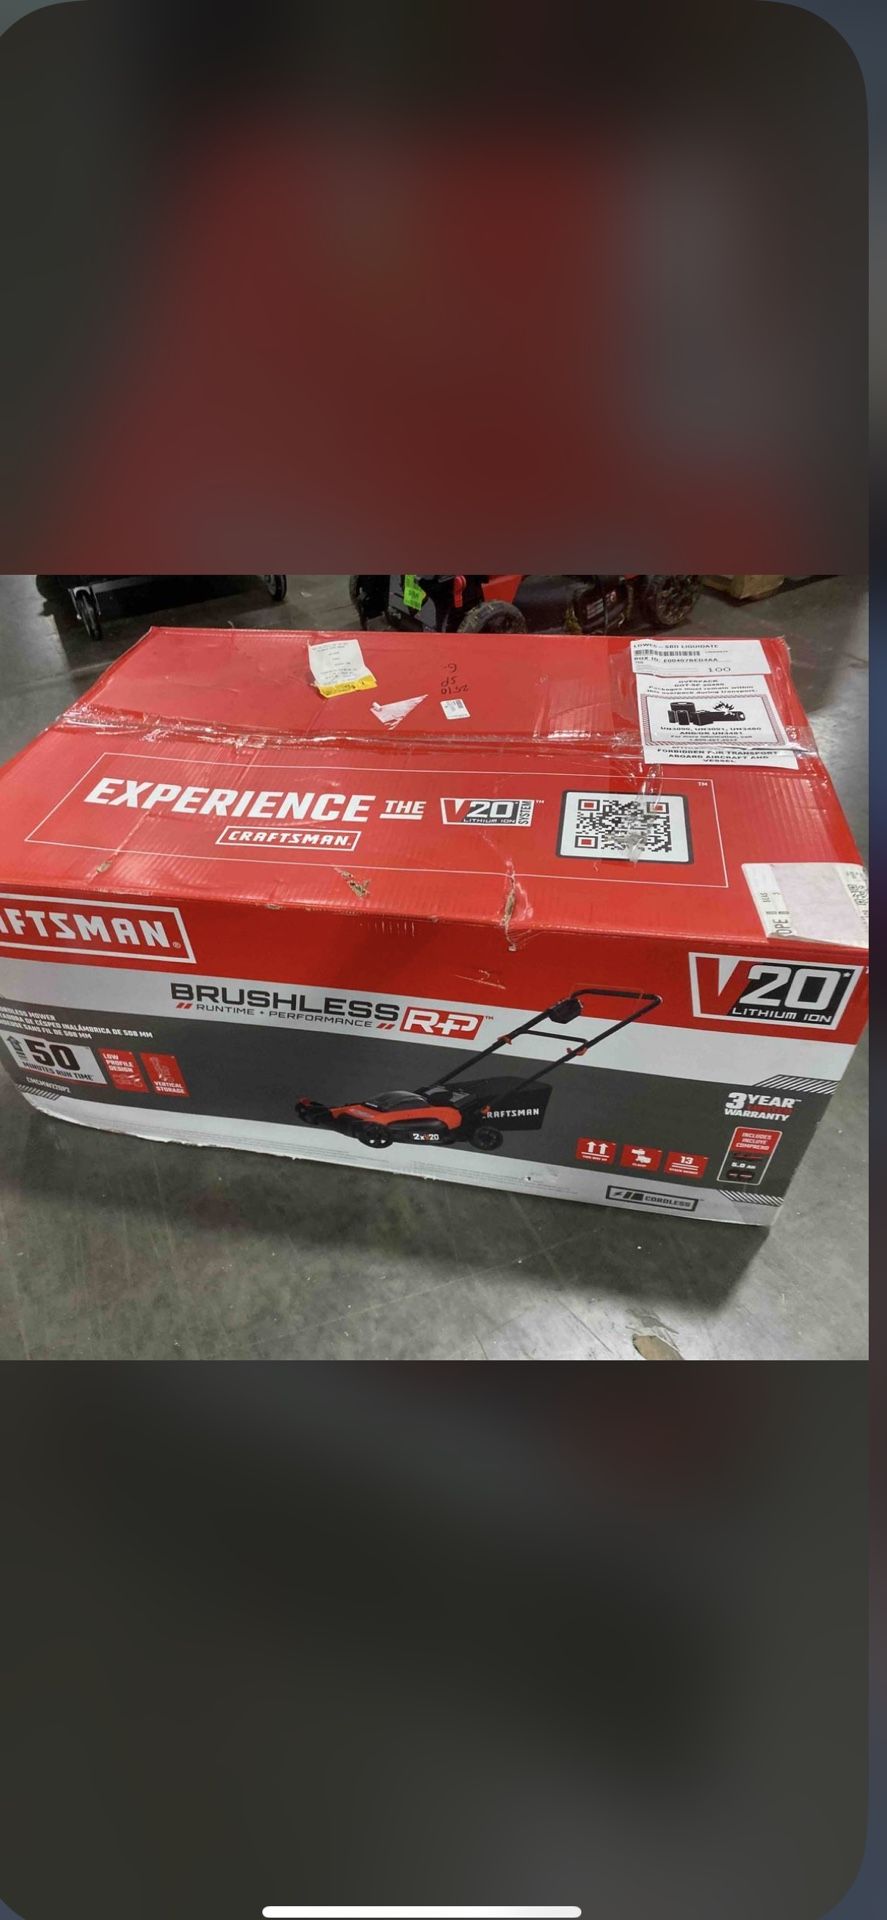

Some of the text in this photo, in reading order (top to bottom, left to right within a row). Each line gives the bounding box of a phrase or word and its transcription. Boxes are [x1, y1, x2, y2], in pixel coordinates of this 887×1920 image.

[84, 777, 376, 822] EXPERIENCE
[384, 800, 427, 815] THE
[518, 801, 532, 824] SYSTEM
[228, 831, 348, 847] CRAFTSMAN
[170, 982, 400, 1022] BRUSHLESS
[28, 1011, 56, 1021] MOWER
[196, 1004, 255, 1016] RUNTIME
[269, 1010, 372, 1028] PERFORMANCE
[732, 1007, 833, 1023] LITHIUM ION
[23, 1024, 41, 1032] SANS
[41, 1027, 53, 1035] FIL
[62, 1022, 111, 1035] INALÁMBRICA
[112, 1029, 121, 1037] DE
[139, 1031, 153, 1039] MM
[24, 1038, 81, 1071] 50
[103, 1052, 119, 1060] LOW
[22, 1061, 55, 1074] MINUTES
[55, 1069, 72, 1078] RUN
[106, 1059, 134, 1068] PROFILE
[108, 1065, 134, 1073] DESIGN
[156, 1086, 186, 1094] STORAGE
[725, 1092, 747, 1110] 3
[482, 1108, 539, 1119] RAFTSMAN
[724, 1108, 791, 1121] WARRANTY
[741, 1132, 772, 1140] INCLUDES
[735, 1142, 770, 1150] COMPREND
[680, 1155, 694, 1165] 13
[644, 1195, 691, 1207] CORDLESS
